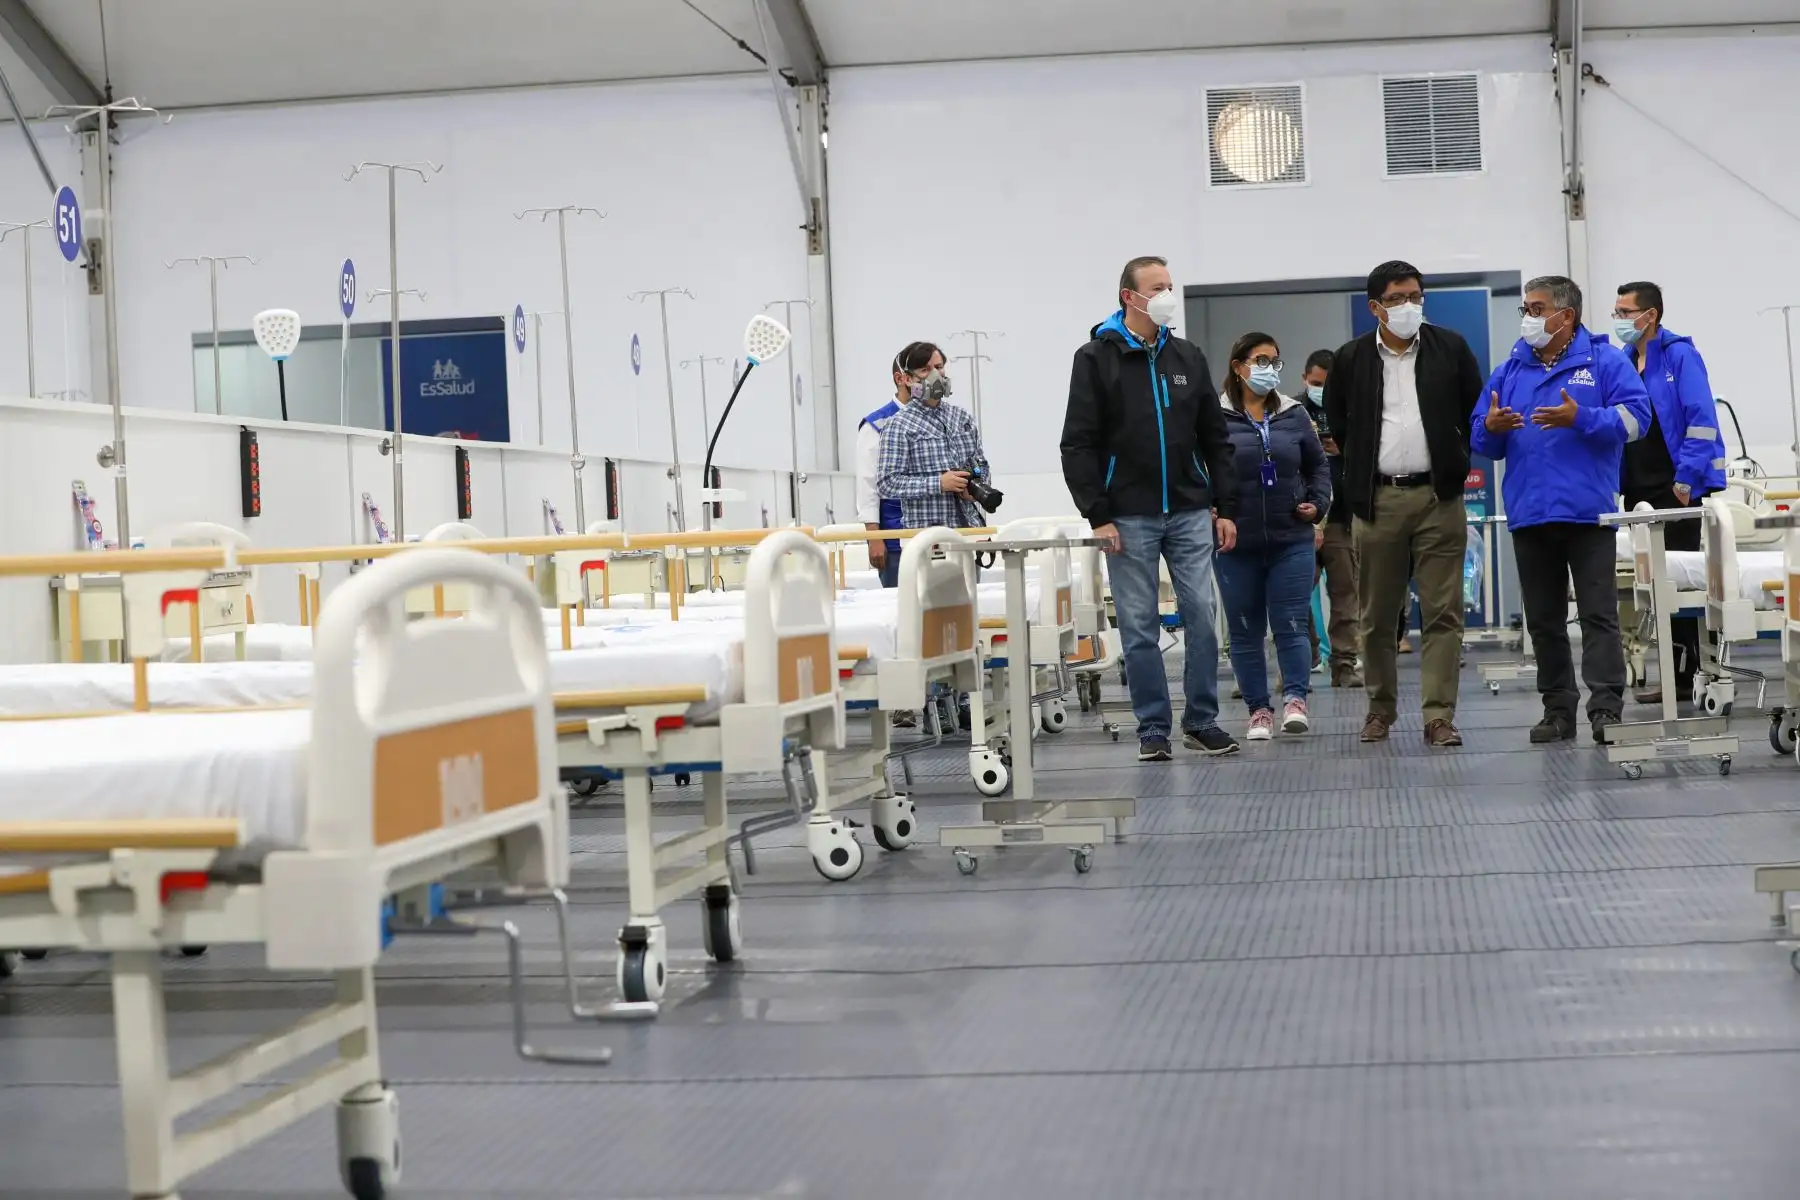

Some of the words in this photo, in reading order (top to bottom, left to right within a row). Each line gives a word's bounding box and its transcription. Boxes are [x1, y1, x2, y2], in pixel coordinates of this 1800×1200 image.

[59, 204, 77, 244] 51
[343, 273, 355, 305] 50
[515, 317, 525, 342] 49
[420, 380, 475, 397] EsSalud
[1567, 379, 1596, 387] EsSalud
